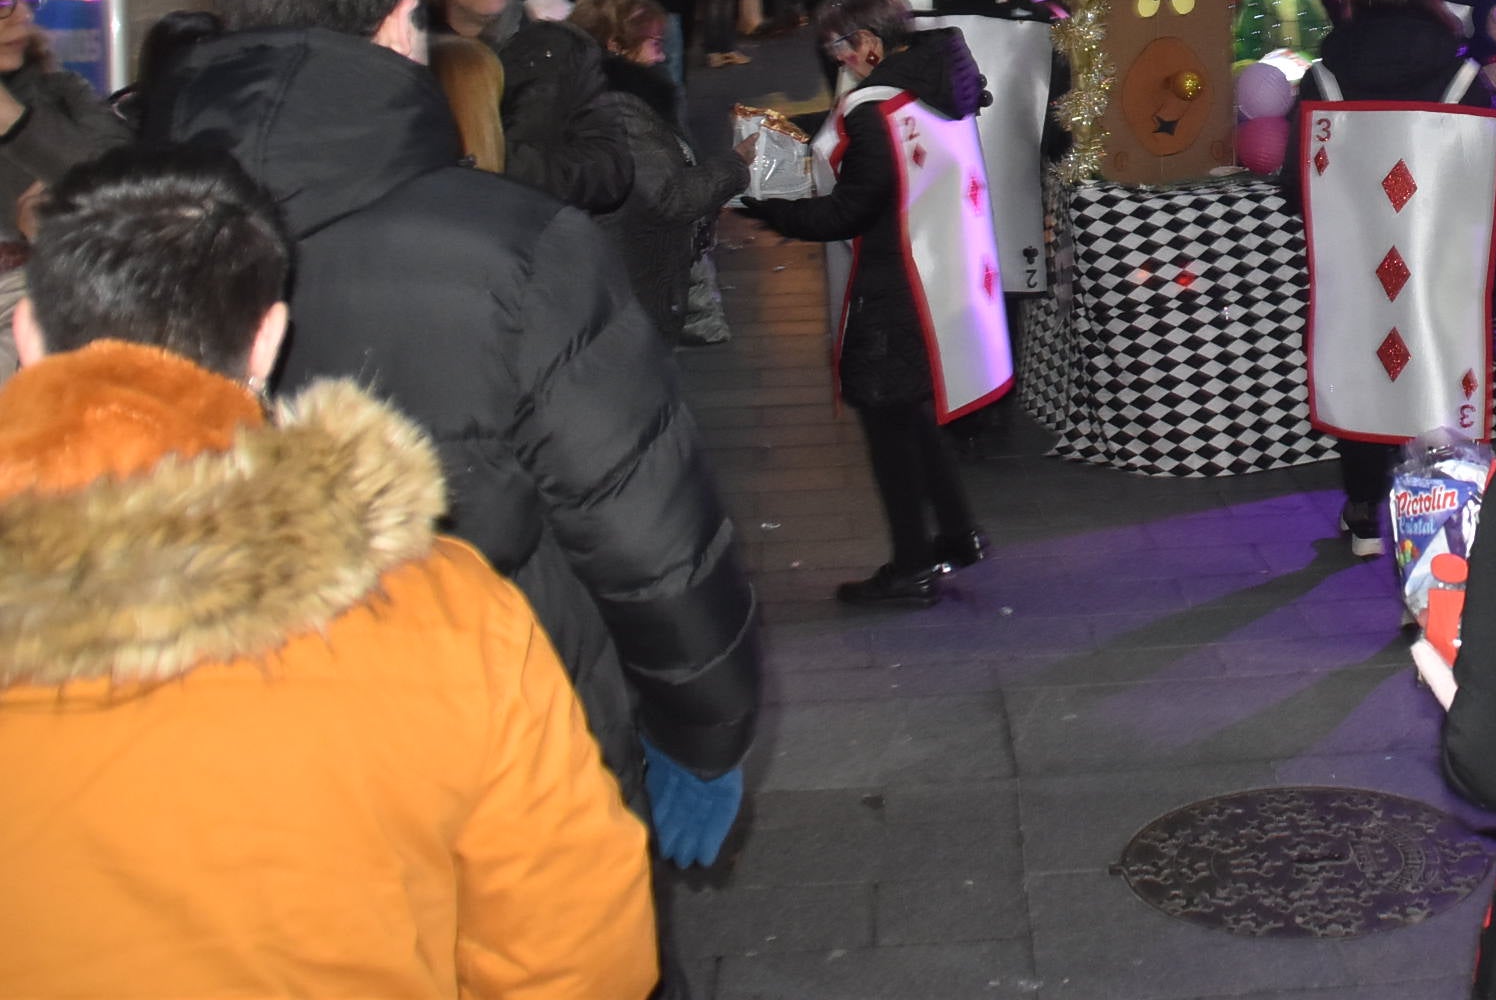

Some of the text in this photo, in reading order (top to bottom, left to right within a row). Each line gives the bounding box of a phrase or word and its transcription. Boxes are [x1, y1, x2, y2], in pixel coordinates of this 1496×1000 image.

[904, 115, 920, 141] 2
[1315, 118, 1332, 142] 3
[1025, 269, 1038, 289] 2
[1459, 403, 1477, 429] 3
[1395, 485, 1458, 519] Pictolin
